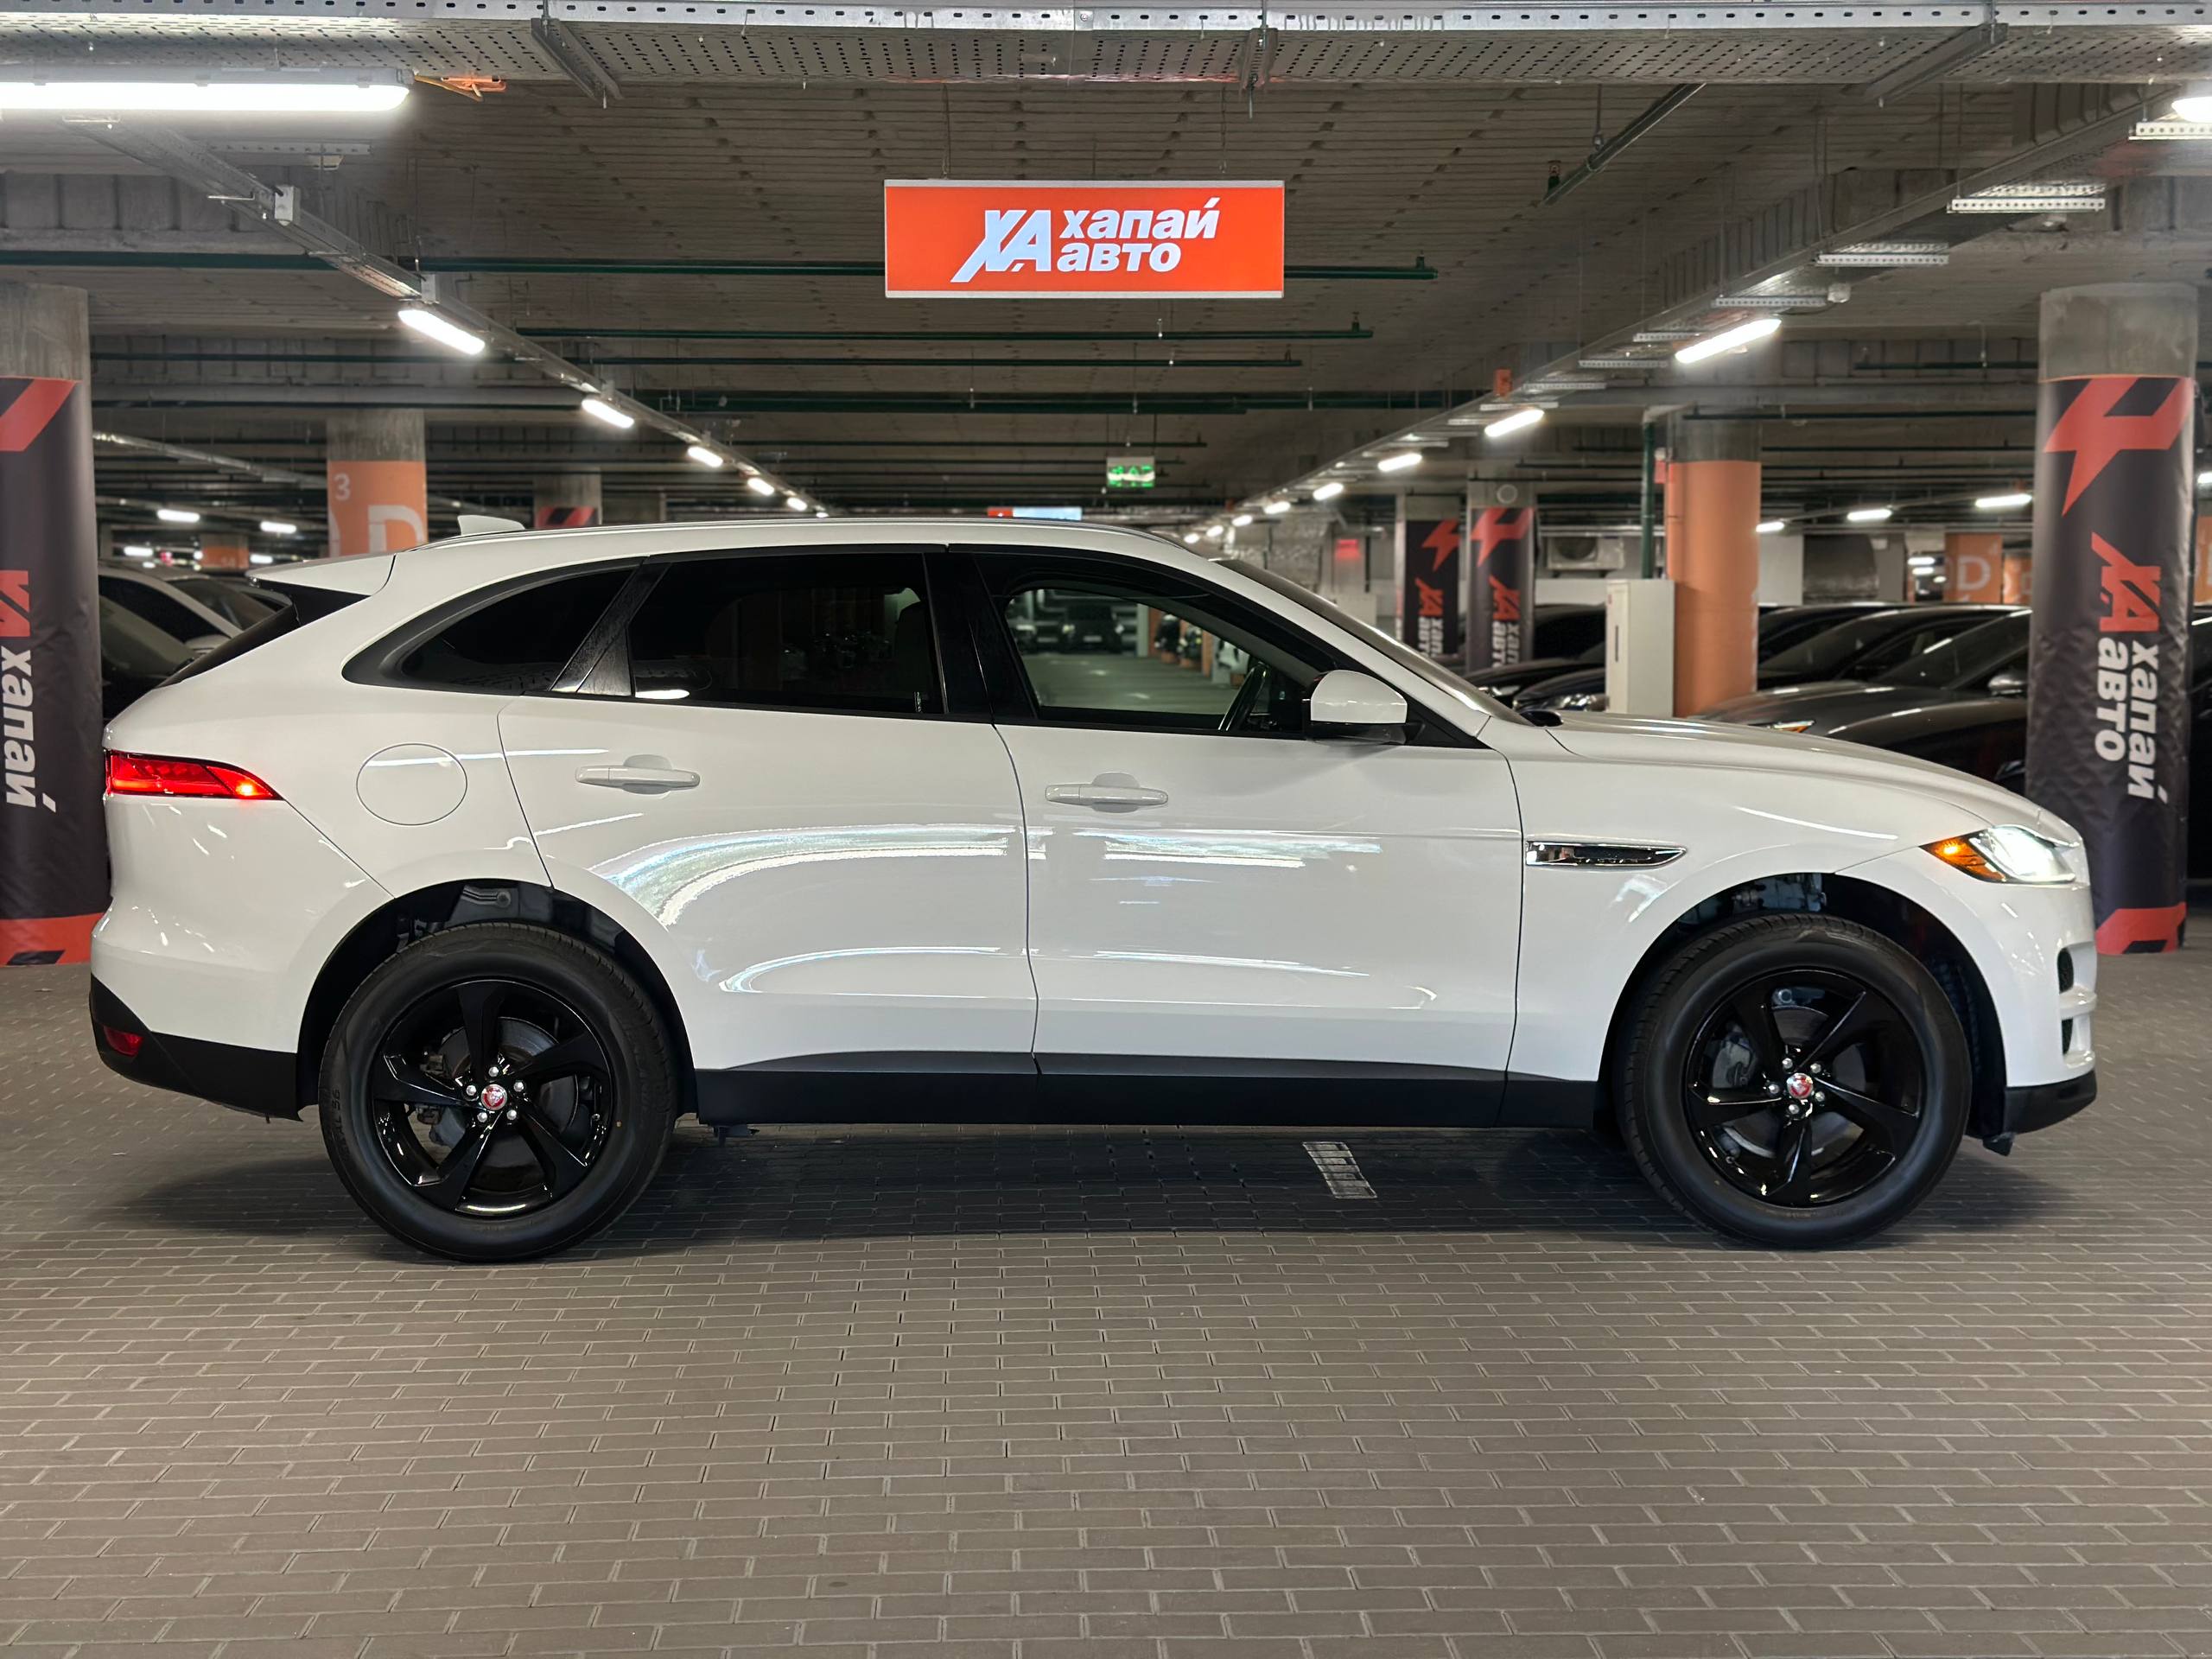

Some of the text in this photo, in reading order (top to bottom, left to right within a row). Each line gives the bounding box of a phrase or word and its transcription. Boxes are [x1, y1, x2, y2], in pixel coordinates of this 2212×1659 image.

[1059, 197, 1221, 239] хапай
[1057, 243, 1181, 271] авто
[334, 473, 350, 500] 3
[1957, 556, 1991, 591] D
[2094, 638, 2128, 761] авто
[1, 646, 56, 812] хапай
[2128, 640, 2168, 804] хапай
